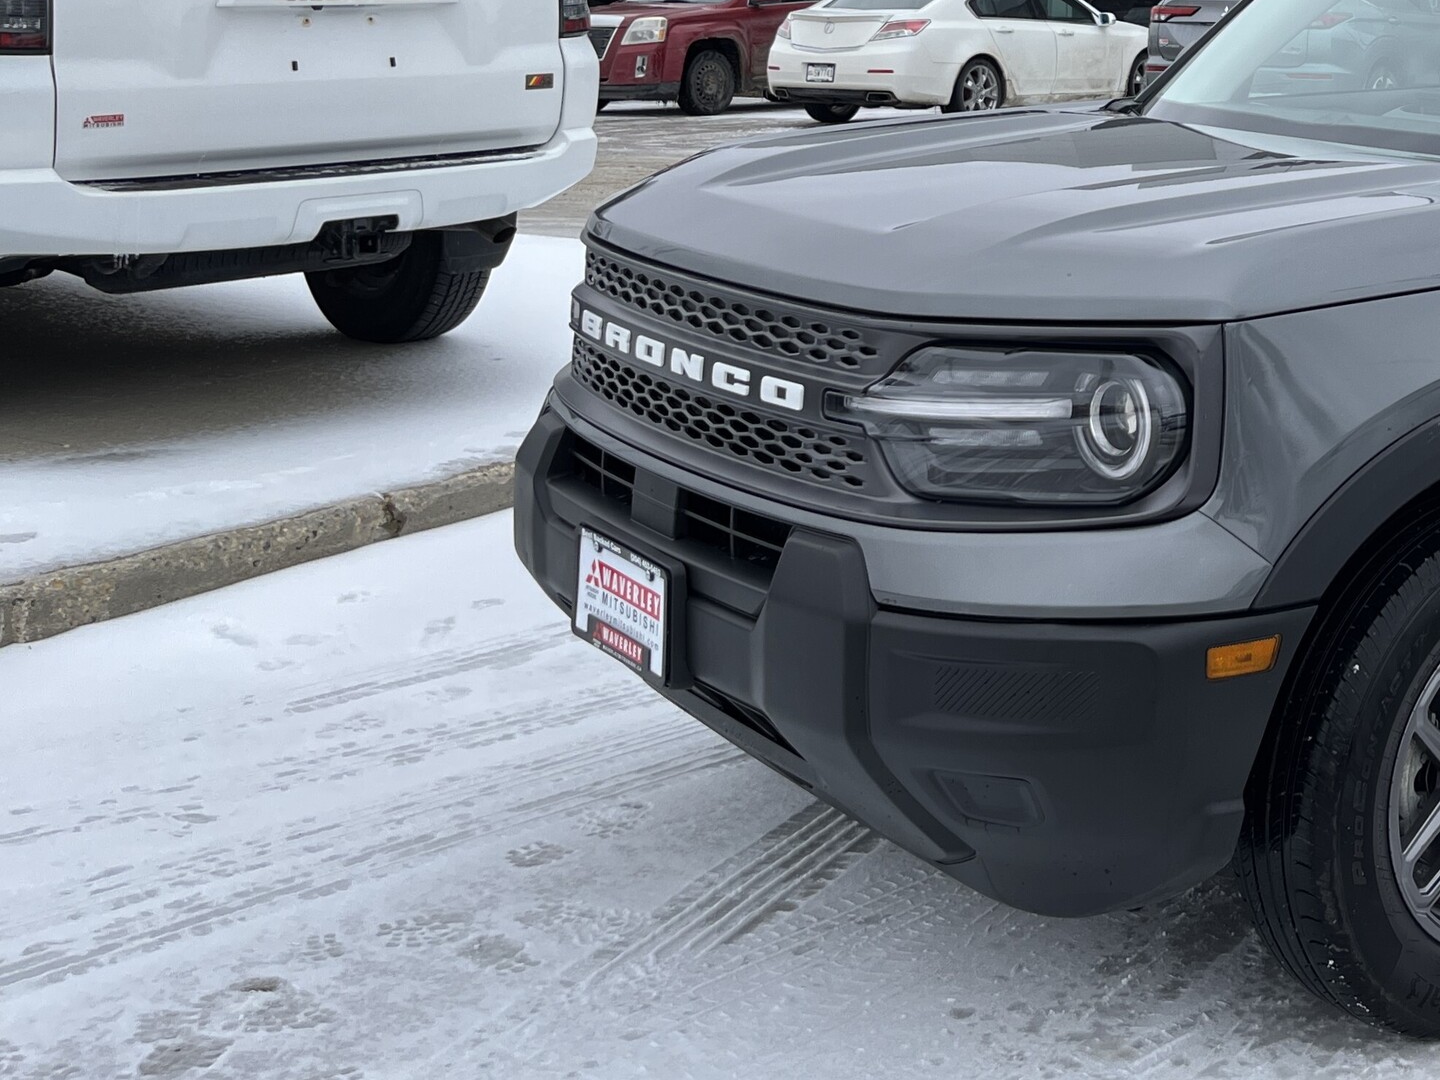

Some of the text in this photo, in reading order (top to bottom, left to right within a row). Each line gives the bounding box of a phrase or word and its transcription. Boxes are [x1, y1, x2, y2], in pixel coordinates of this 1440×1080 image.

[581, 308, 805, 412] BRONCO
[601, 590, 660, 637] MITSUBISHI
[602, 565, 661, 617] WAVERLEY
[602, 625, 643, 662] WAVERLEY
